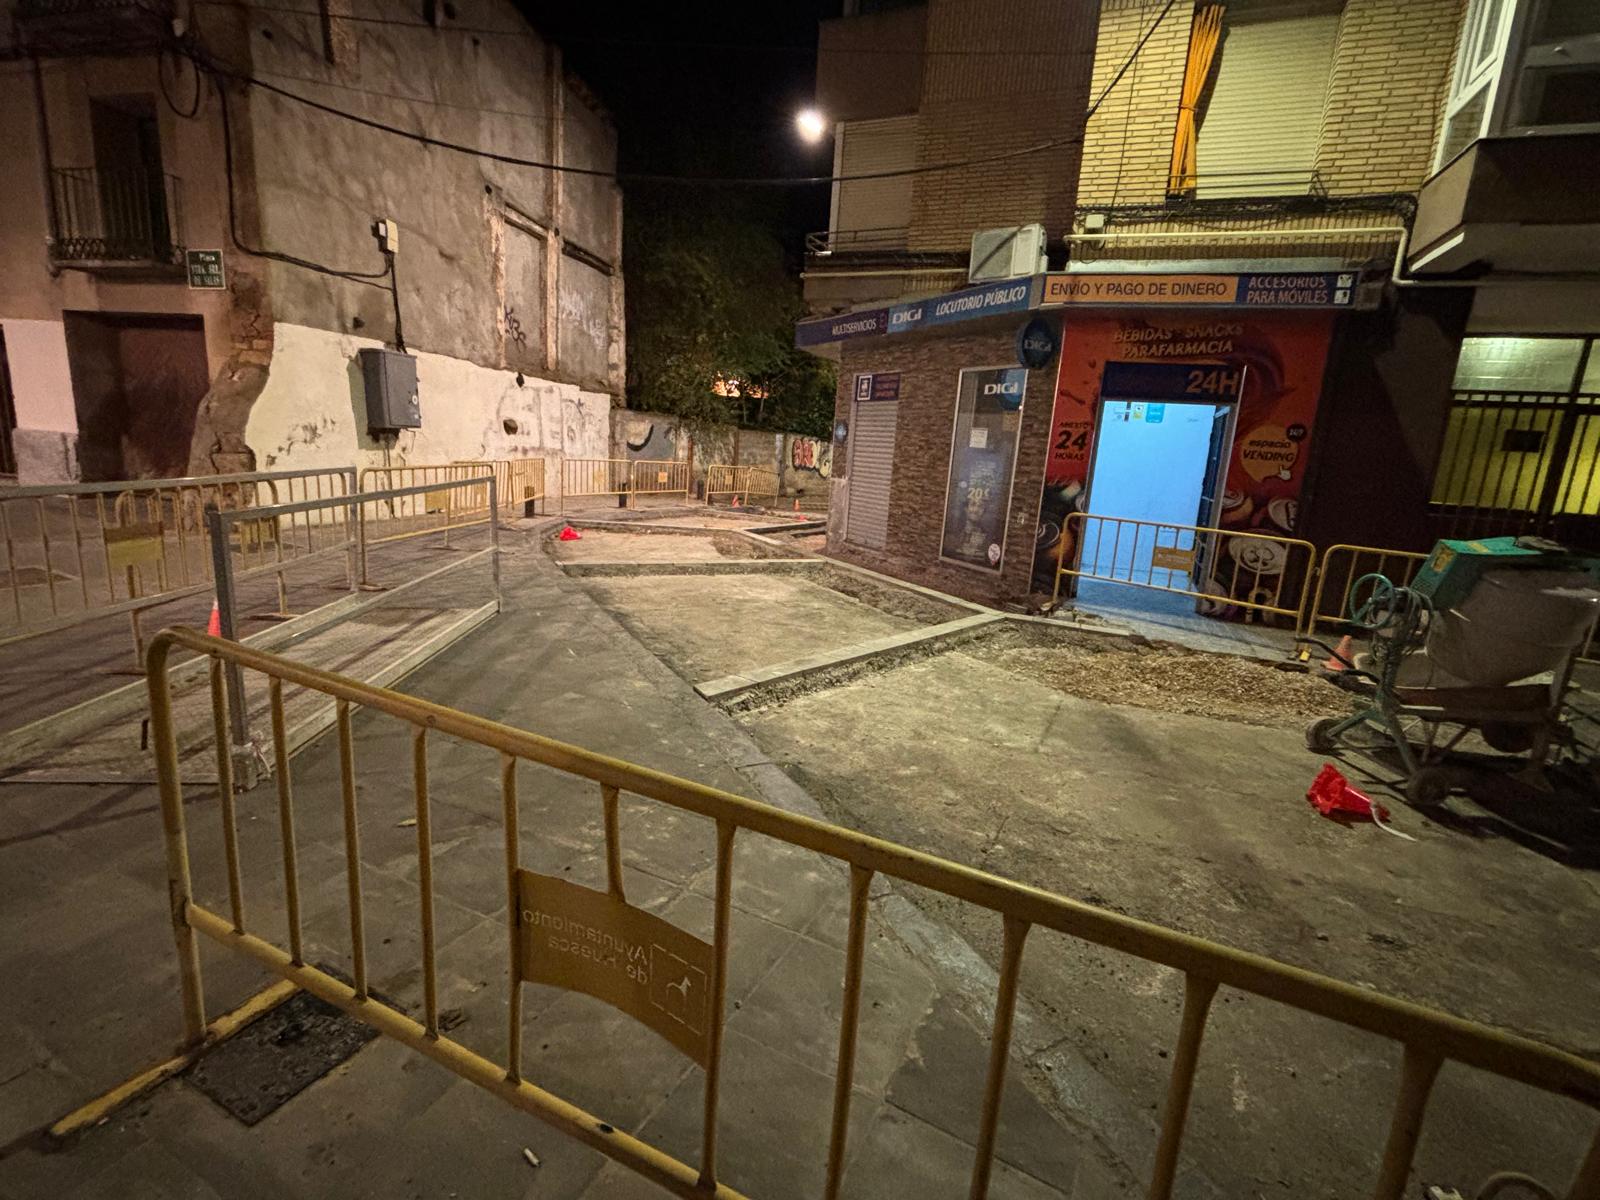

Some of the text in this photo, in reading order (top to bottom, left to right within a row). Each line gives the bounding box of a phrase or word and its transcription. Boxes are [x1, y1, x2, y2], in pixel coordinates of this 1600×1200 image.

[1050, 280, 1227, 296] ENVÍO Y PAGO DE DINERO
[1248, 275, 1327, 289] ACCESORIOS
[936, 286, 1026, 316] LOCUTORIO PÚBLICO
[1246, 289, 1328, 305] PARA MÓVILES
[891, 308, 922, 325] DIGI
[831, 318, 877, 336] MULTISERVICIOS
[1113, 327, 1173, 343] BEBIDAS
[1121, 340, 1234, 359] PARAFARMACIA
[983, 382, 1018, 395] DIGI
[1185, 370, 1241, 395] 24H
[1055, 430, 1089, 452] 24
[1243, 449, 1295, 462] VENDING
